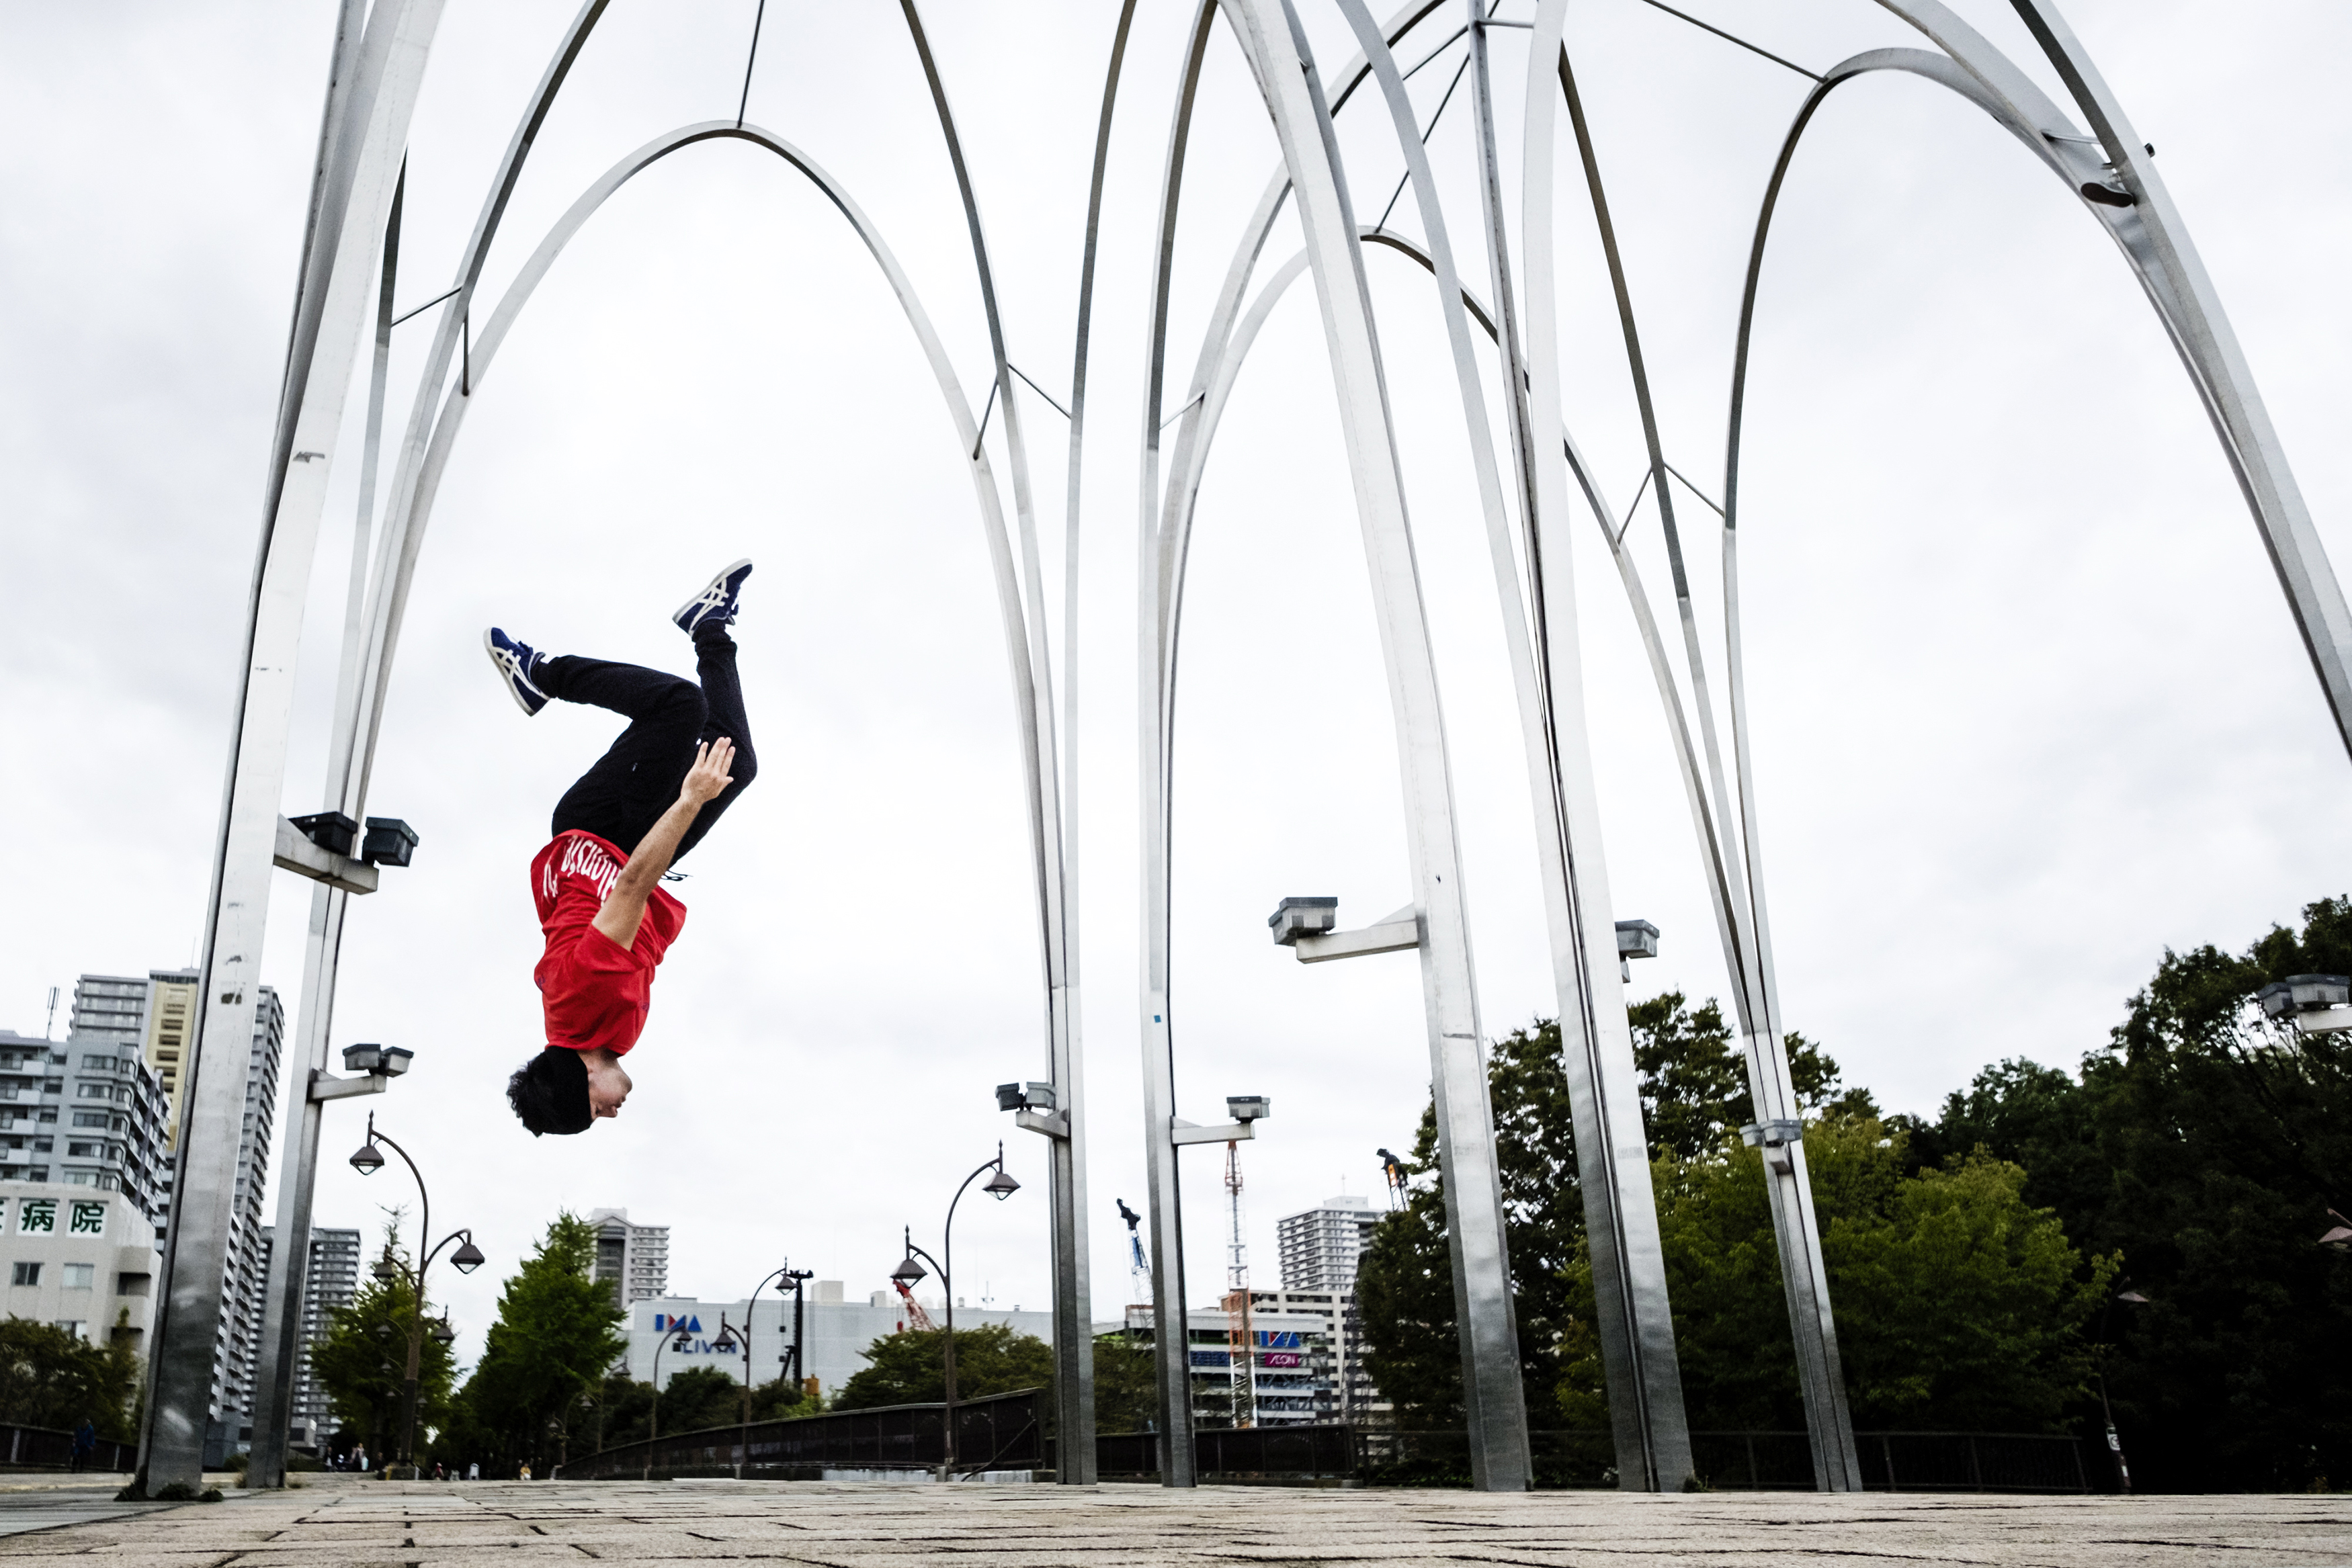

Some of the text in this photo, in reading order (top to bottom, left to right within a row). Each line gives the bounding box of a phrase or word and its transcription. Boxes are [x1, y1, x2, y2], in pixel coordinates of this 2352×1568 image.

[0, 1199, 104, 1233] 病院
[655, 1314, 702, 1332] IMA
[683, 1340, 737, 1354] LIVN
